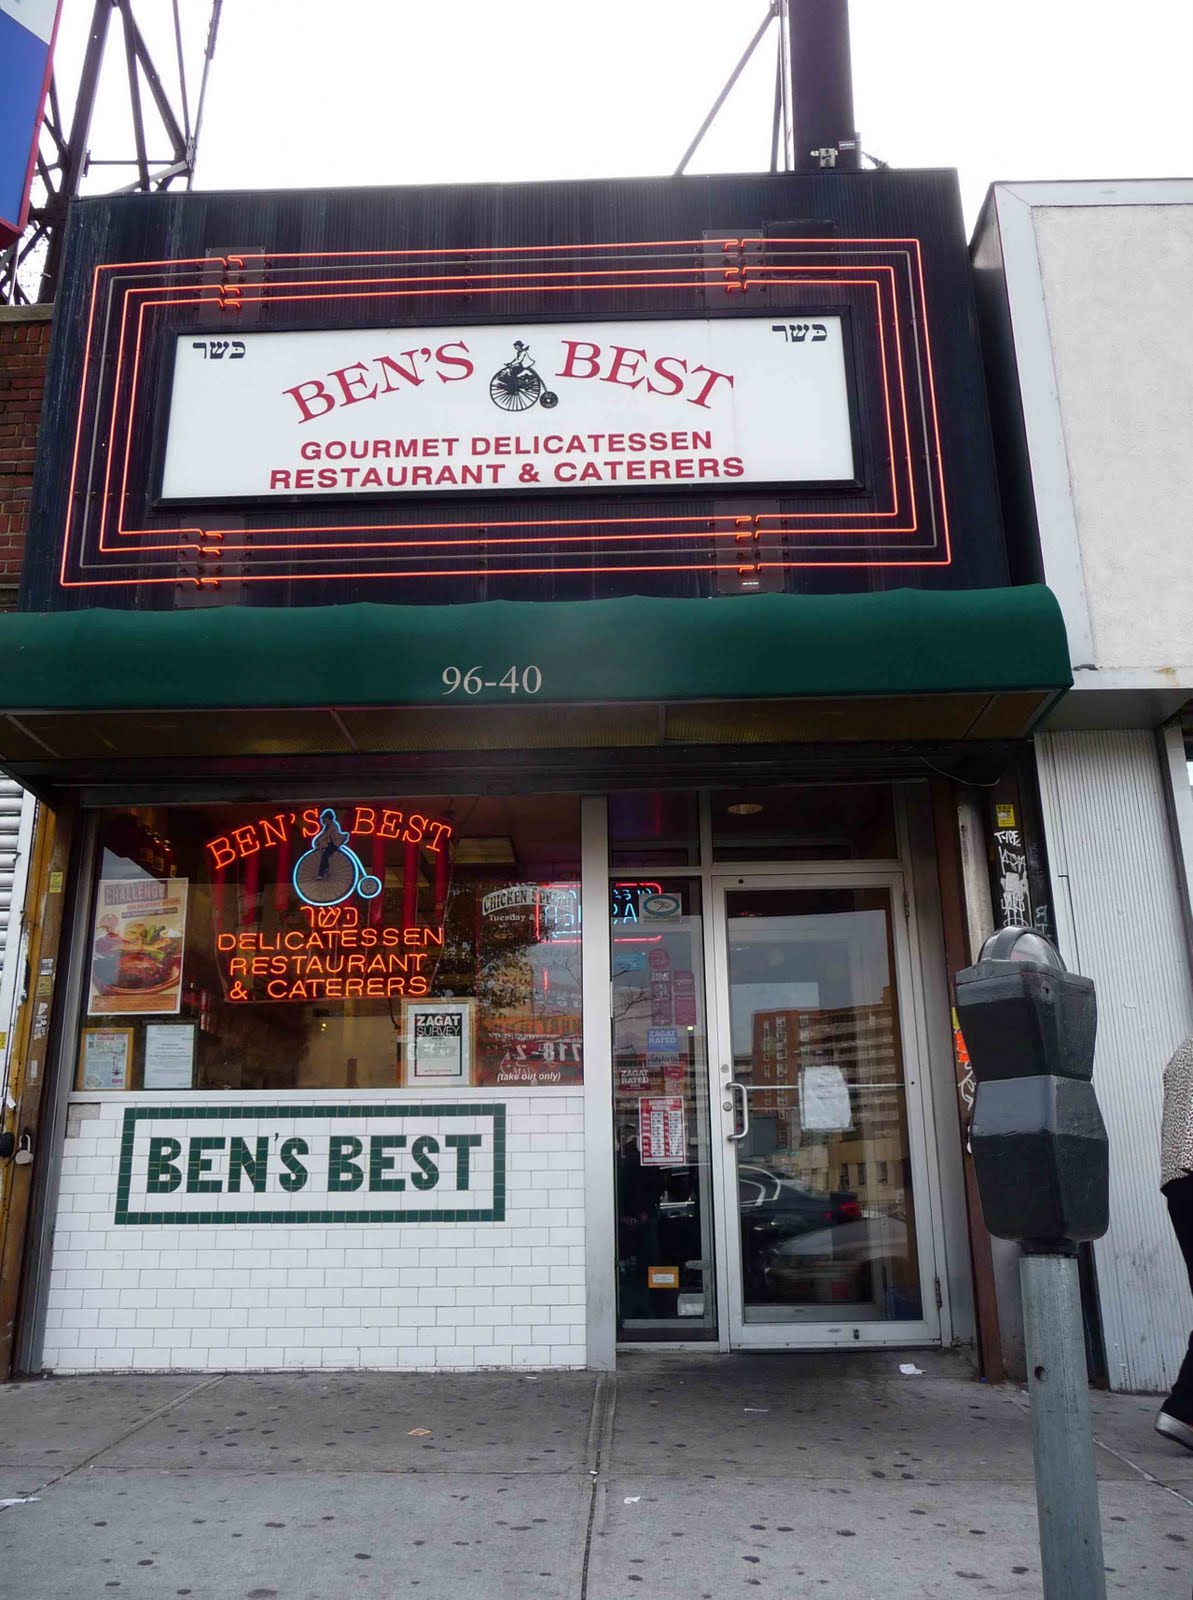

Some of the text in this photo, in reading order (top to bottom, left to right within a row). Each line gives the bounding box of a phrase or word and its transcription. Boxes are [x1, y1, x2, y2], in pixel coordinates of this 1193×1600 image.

[283, 340, 734, 422] BEN'S BEST
[301, 431, 713, 460] GOURMET DELICATESSEN
[270, 456, 745, 490] RESTAURANT & CATERERS
[442, 665, 542, 695] 96-40
[207, 807, 452, 869] BEN'S BEST
[483, 889, 528, 913] CHICKEN
[489, 914, 526, 922] Tuesday
[217, 927, 443, 951] DELICATESSEN
[230, 953, 428, 976] RESTAURANT
[229, 976, 427, 1000] & CATERERS
[416, 1015, 461, 1026] ZAGAT
[416, 1026, 461, 1036] SURVEY
[539, 1072, 561, 1082] only)
[146, 1132, 482, 1193] BEN'S BEST
